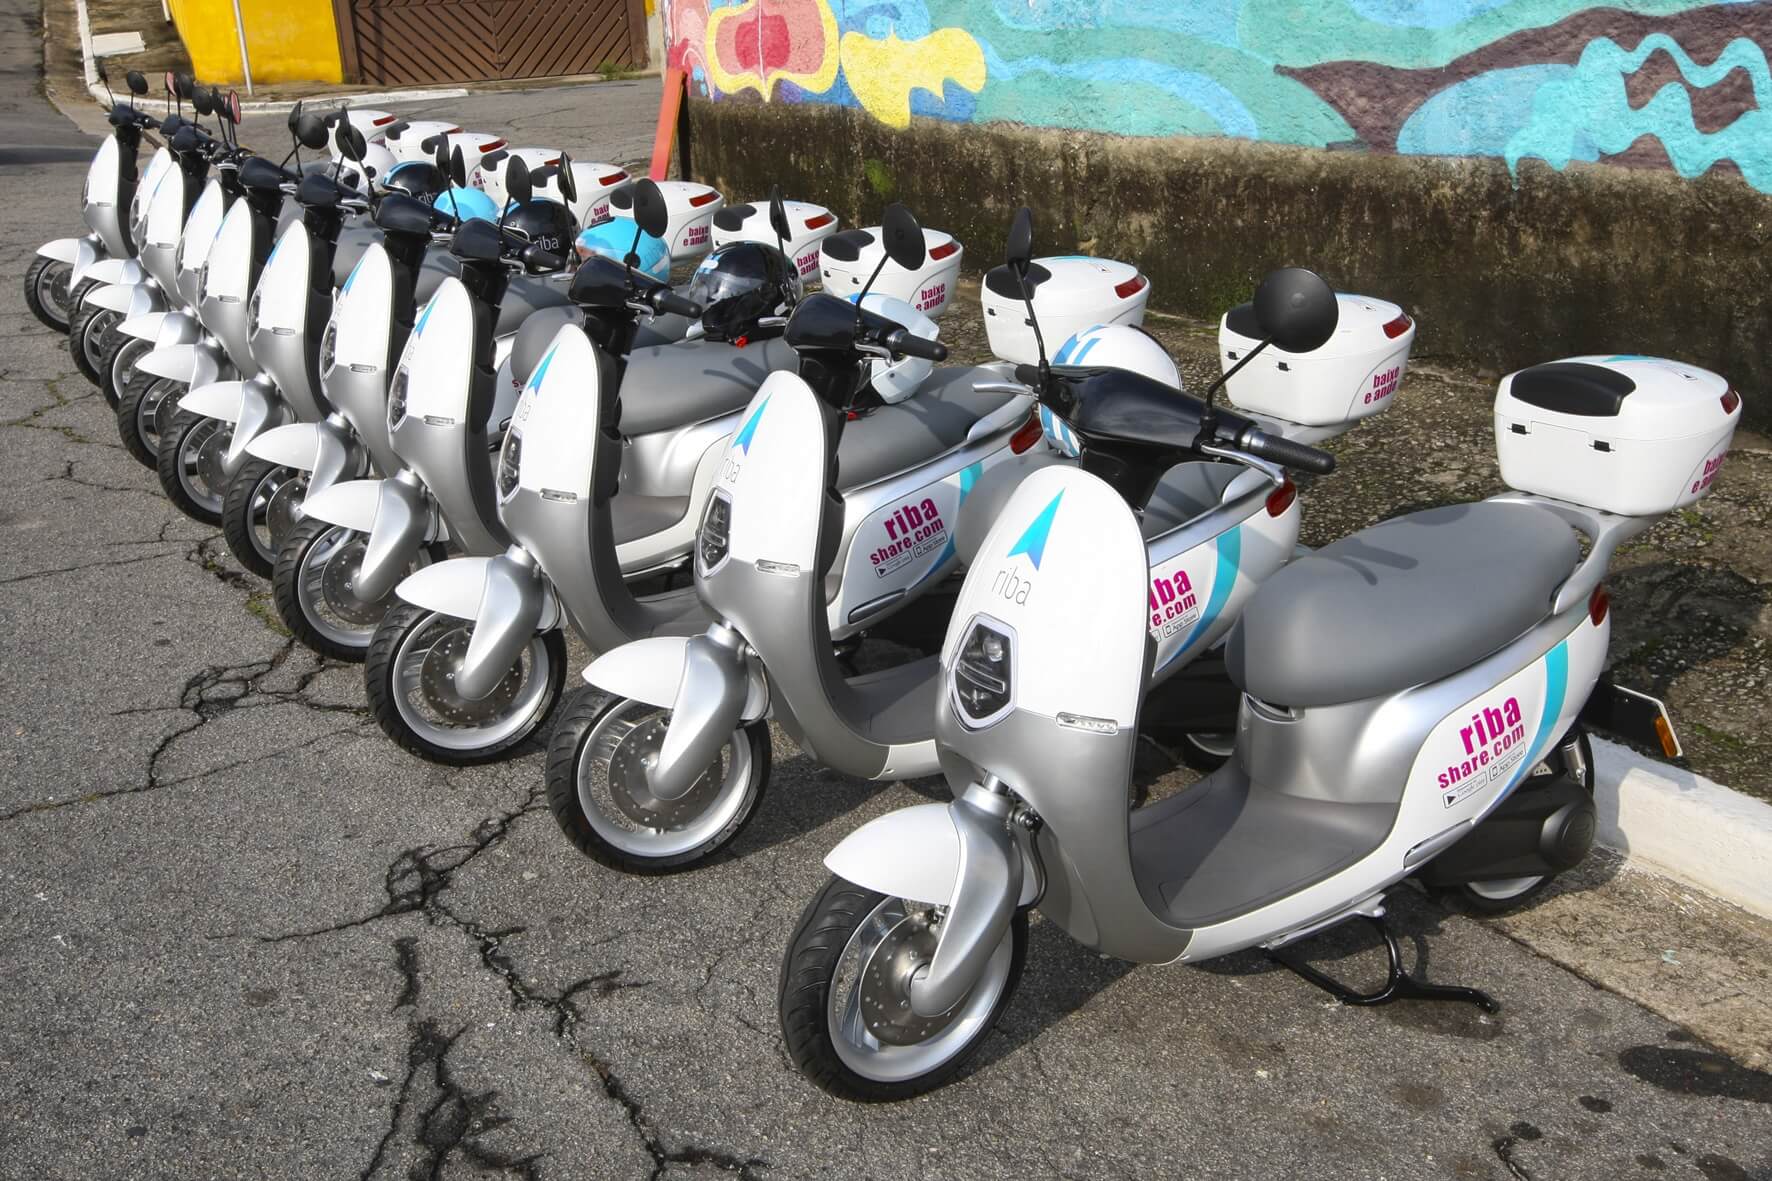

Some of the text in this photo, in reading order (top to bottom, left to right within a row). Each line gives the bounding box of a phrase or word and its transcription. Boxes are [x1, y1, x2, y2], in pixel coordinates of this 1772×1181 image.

[921, 283, 945, 300] baixe
[924, 294, 945, 311] ande
[1373, 366, 1400, 388] baixe
[1364, 392, 1372, 405] e
[1691, 480, 1700, 494] e
[884, 498, 939, 541] riba
[870, 518, 945, 565] share.com
[991, 565, 1032, 606] riba
[1459, 697, 1521, 756] riba
[1438, 724, 1524, 789] share.com
